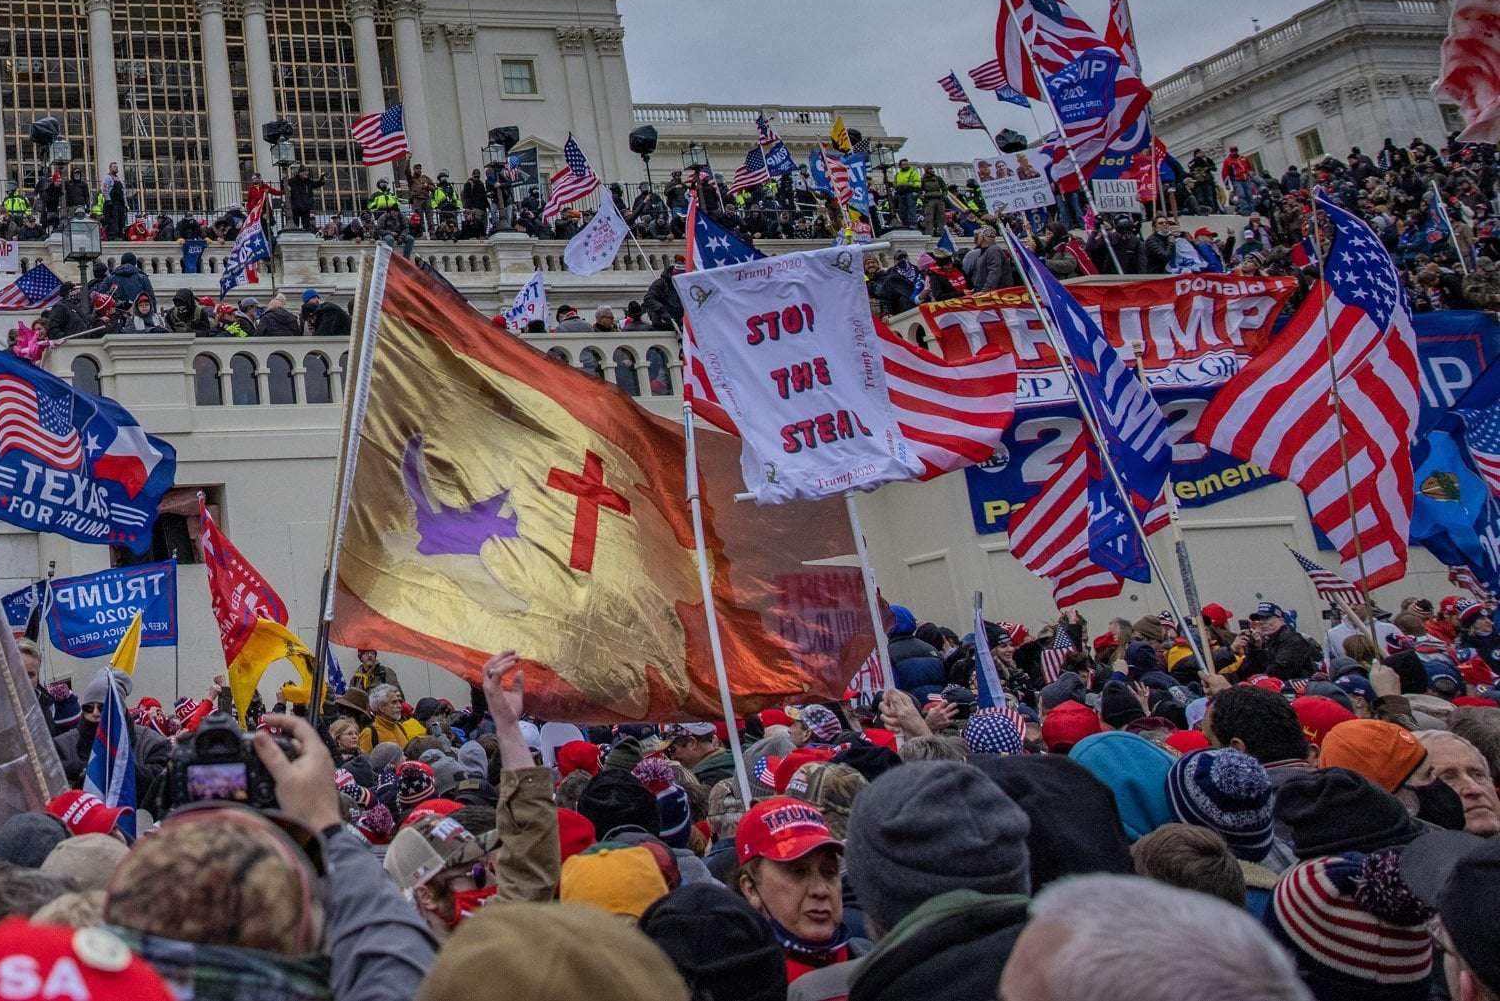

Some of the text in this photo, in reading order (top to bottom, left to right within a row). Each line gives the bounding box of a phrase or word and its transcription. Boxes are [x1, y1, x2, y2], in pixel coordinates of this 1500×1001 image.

[735, 259, 803, 281] Trump 2020
[1175, 278, 1266, 297] Donald
[853, 318, 875, 390] Trump 2020
[770, 357, 832, 400] THE
[21, 460, 110, 519] TEXAS
[815, 463, 877, 489] Trump 2020
[8, 496, 111, 538] FOR TRUMP
[763, 806, 826, 830] TRUMP
